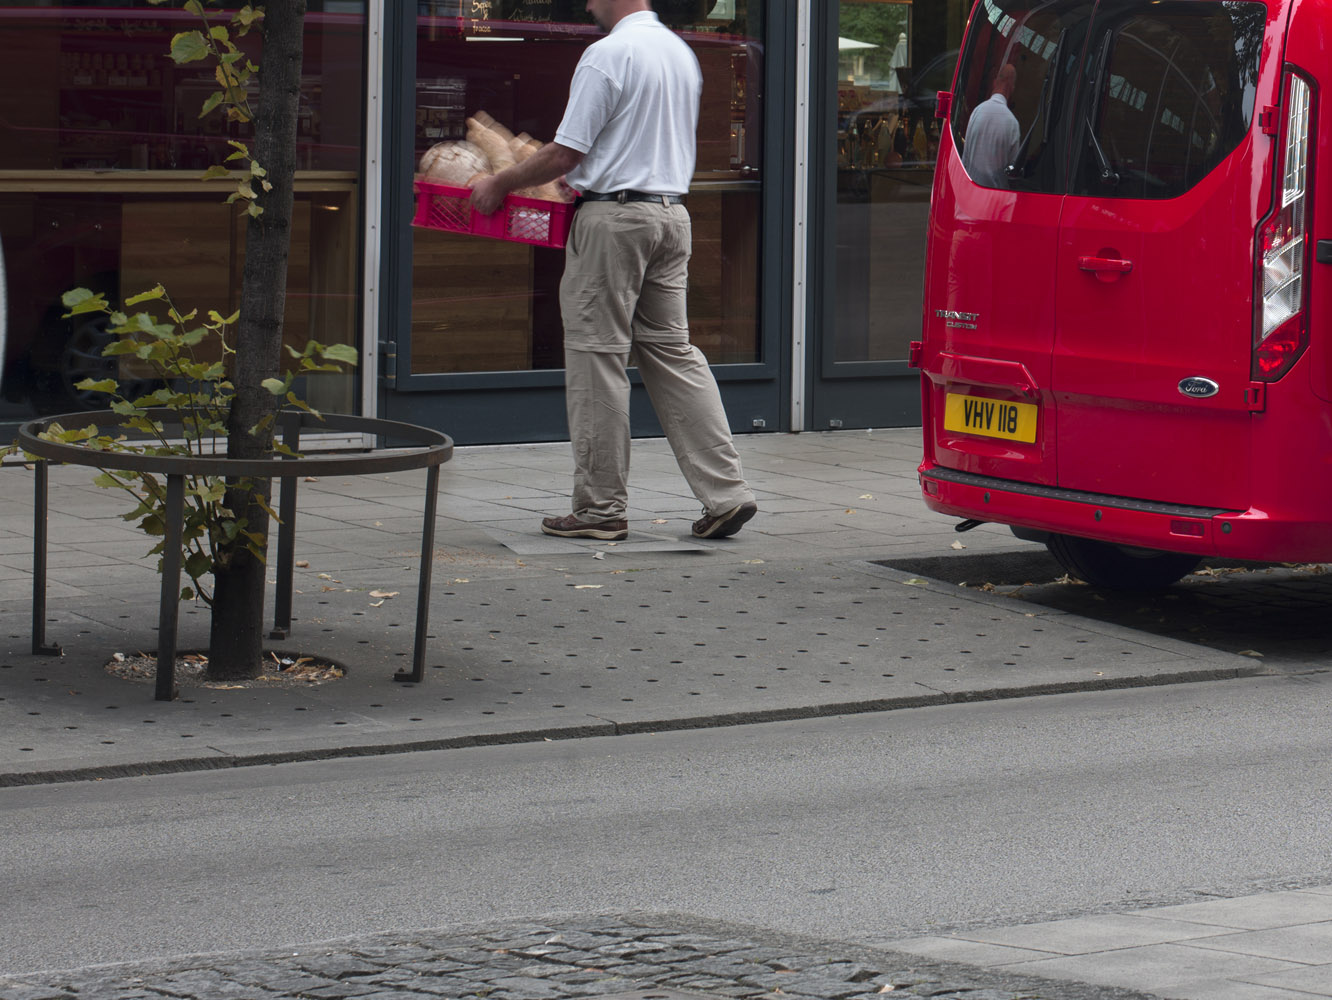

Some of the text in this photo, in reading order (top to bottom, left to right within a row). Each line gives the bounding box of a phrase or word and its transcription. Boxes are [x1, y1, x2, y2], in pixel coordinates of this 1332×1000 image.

[935, 309, 980, 321] TRANSIT
[946, 321, 978, 330] CUSTOM
[1185, 380, 1208, 393] Ford
[964, 399, 1018, 434] VHV 118
